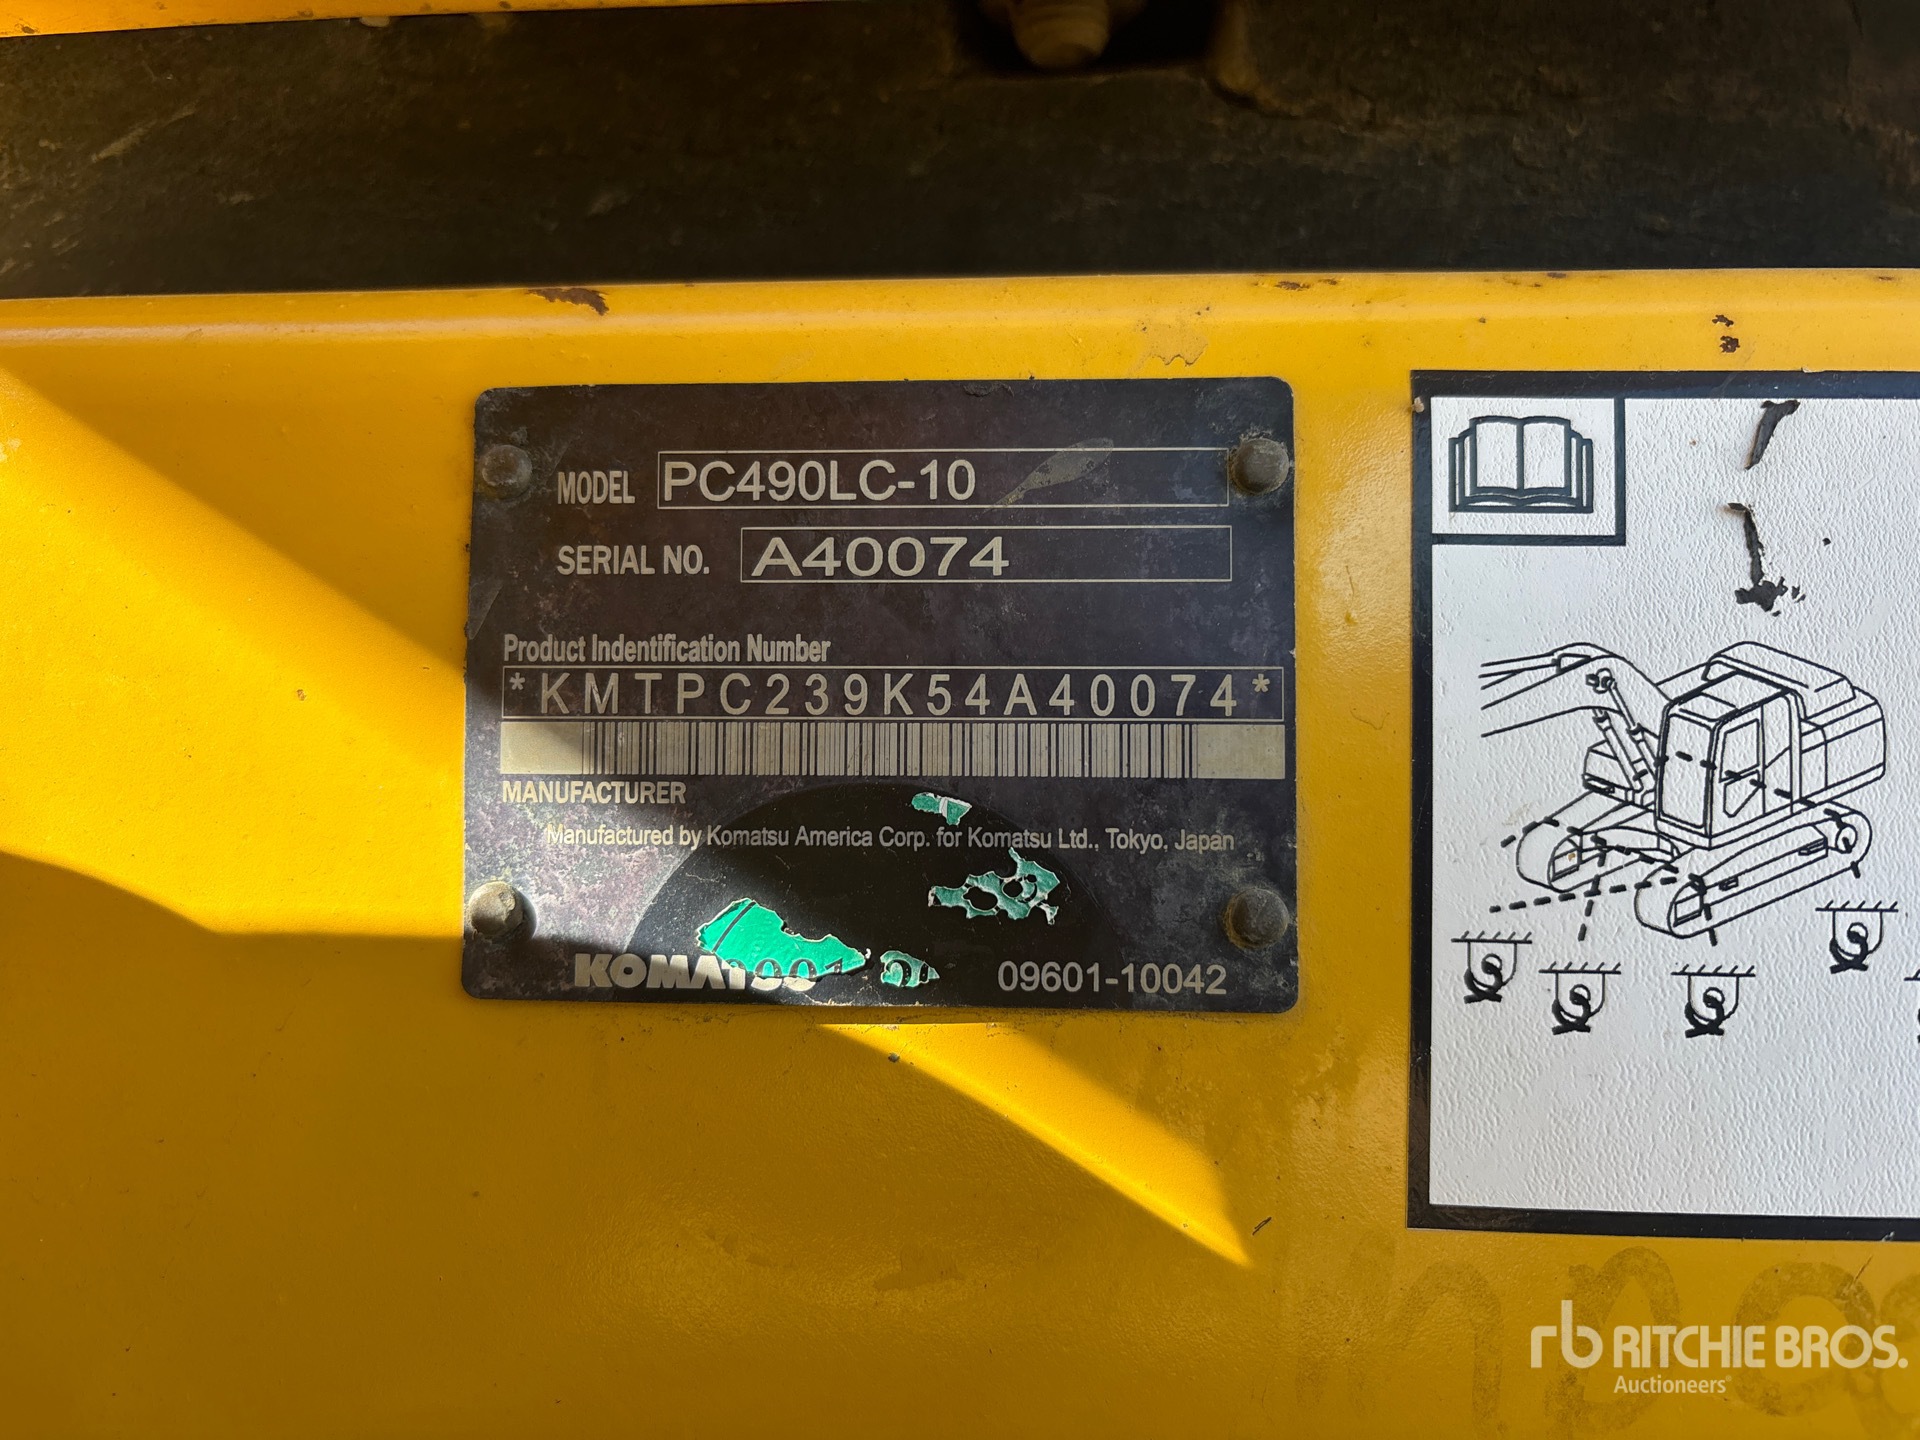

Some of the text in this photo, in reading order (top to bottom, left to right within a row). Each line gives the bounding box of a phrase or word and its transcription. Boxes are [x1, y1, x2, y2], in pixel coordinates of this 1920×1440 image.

[557, 460, 976, 504] MODEL PC490LC-10
[557, 536, 1010, 577] SERIAL NO. A40074
[504, 633, 832, 662] Product Indentification Number
[502, 781, 686, 804] MANUFACTURER
[546, 824, 674, 846] Manufactured
[679, 825, 701, 850] by
[707, 825, 789, 847] Komatsu
[795, 826, 872, 847] America
[879, 826, 930, 851] Corp.
[937, 826, 963, 848] for
[968, 827, 1052, 849] Komatsu
[1105, 828, 1168, 853] Tokyo,
[1175, 830, 1235, 852] Japan
[997, 960, 1227, 995] 09601-10042
